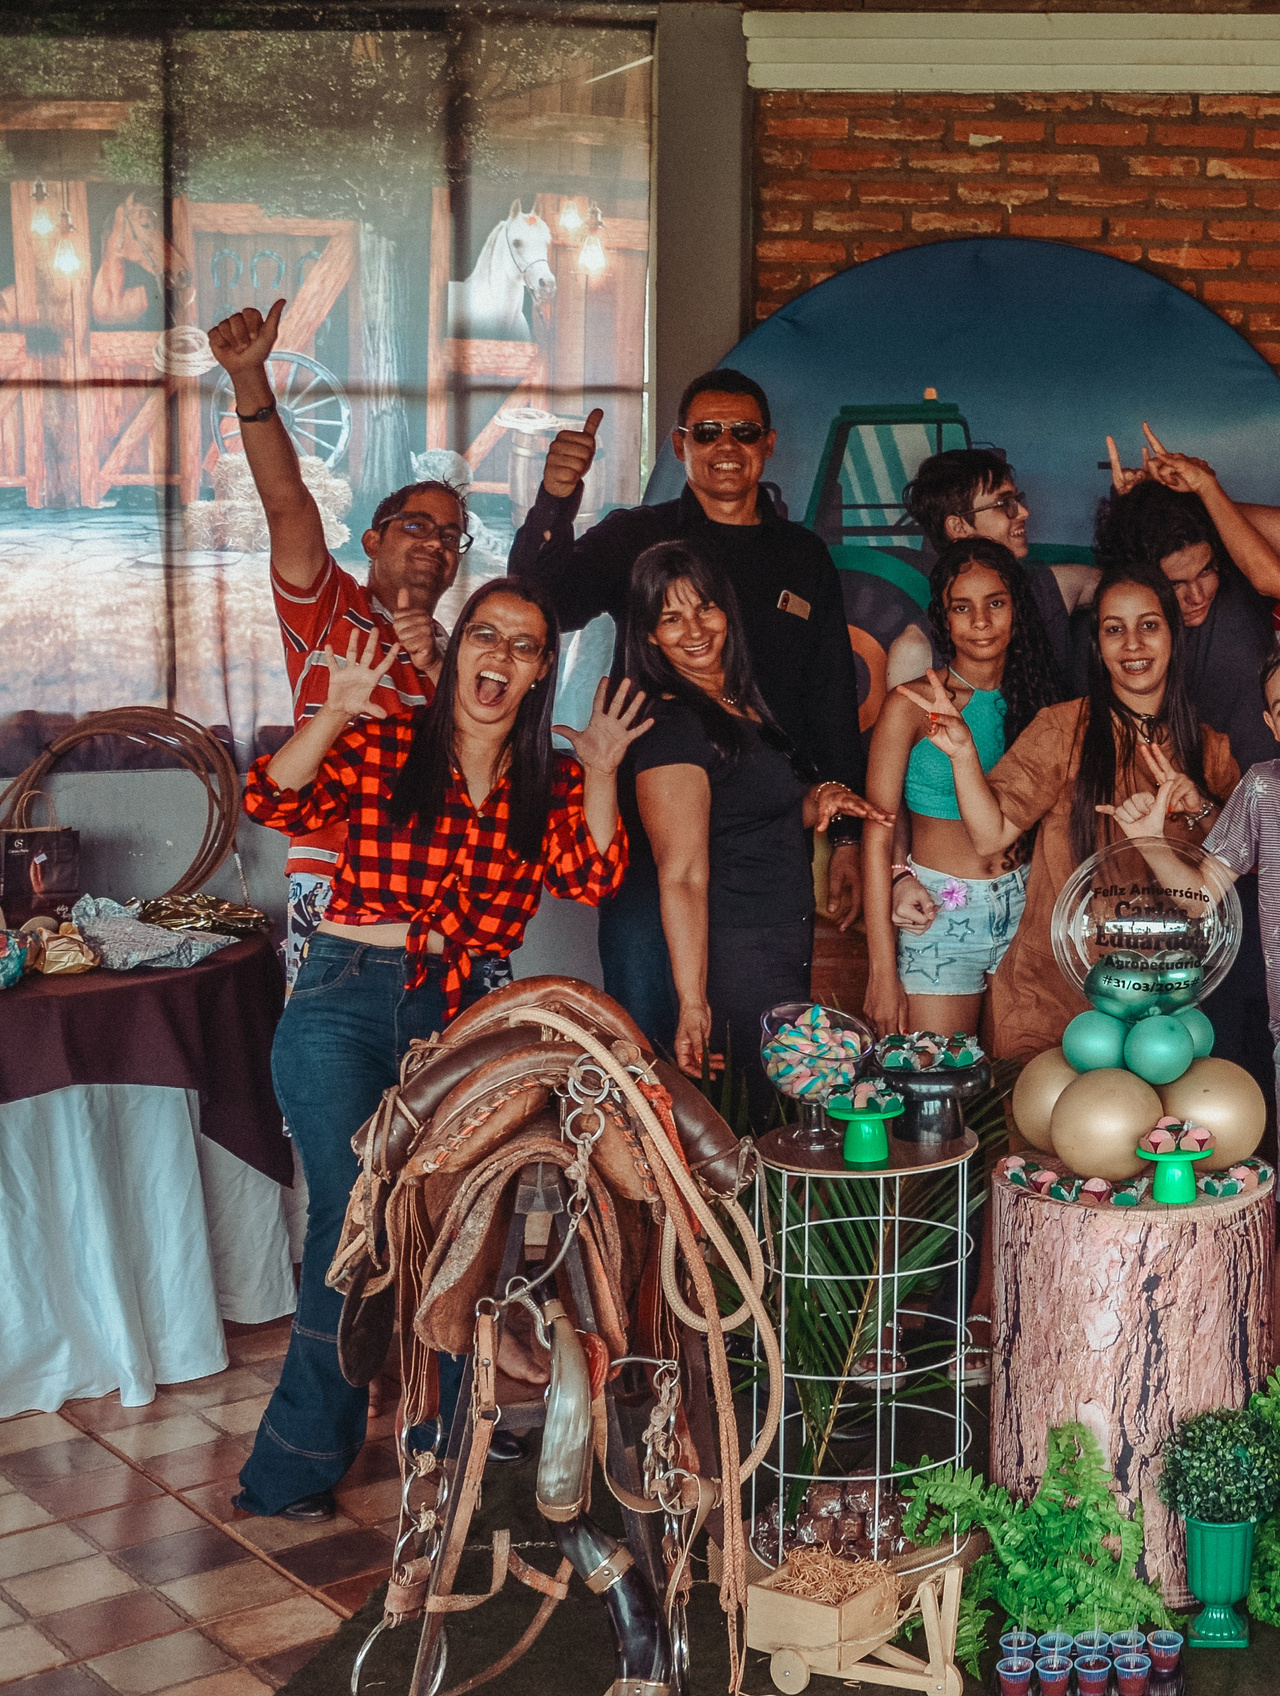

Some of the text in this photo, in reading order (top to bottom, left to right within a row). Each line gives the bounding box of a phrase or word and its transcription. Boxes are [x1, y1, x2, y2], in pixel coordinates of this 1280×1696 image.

[1094, 884, 1210, 902] Feliz Aniversário
[1102, 975, 1200, 992] #31/03/2025#
